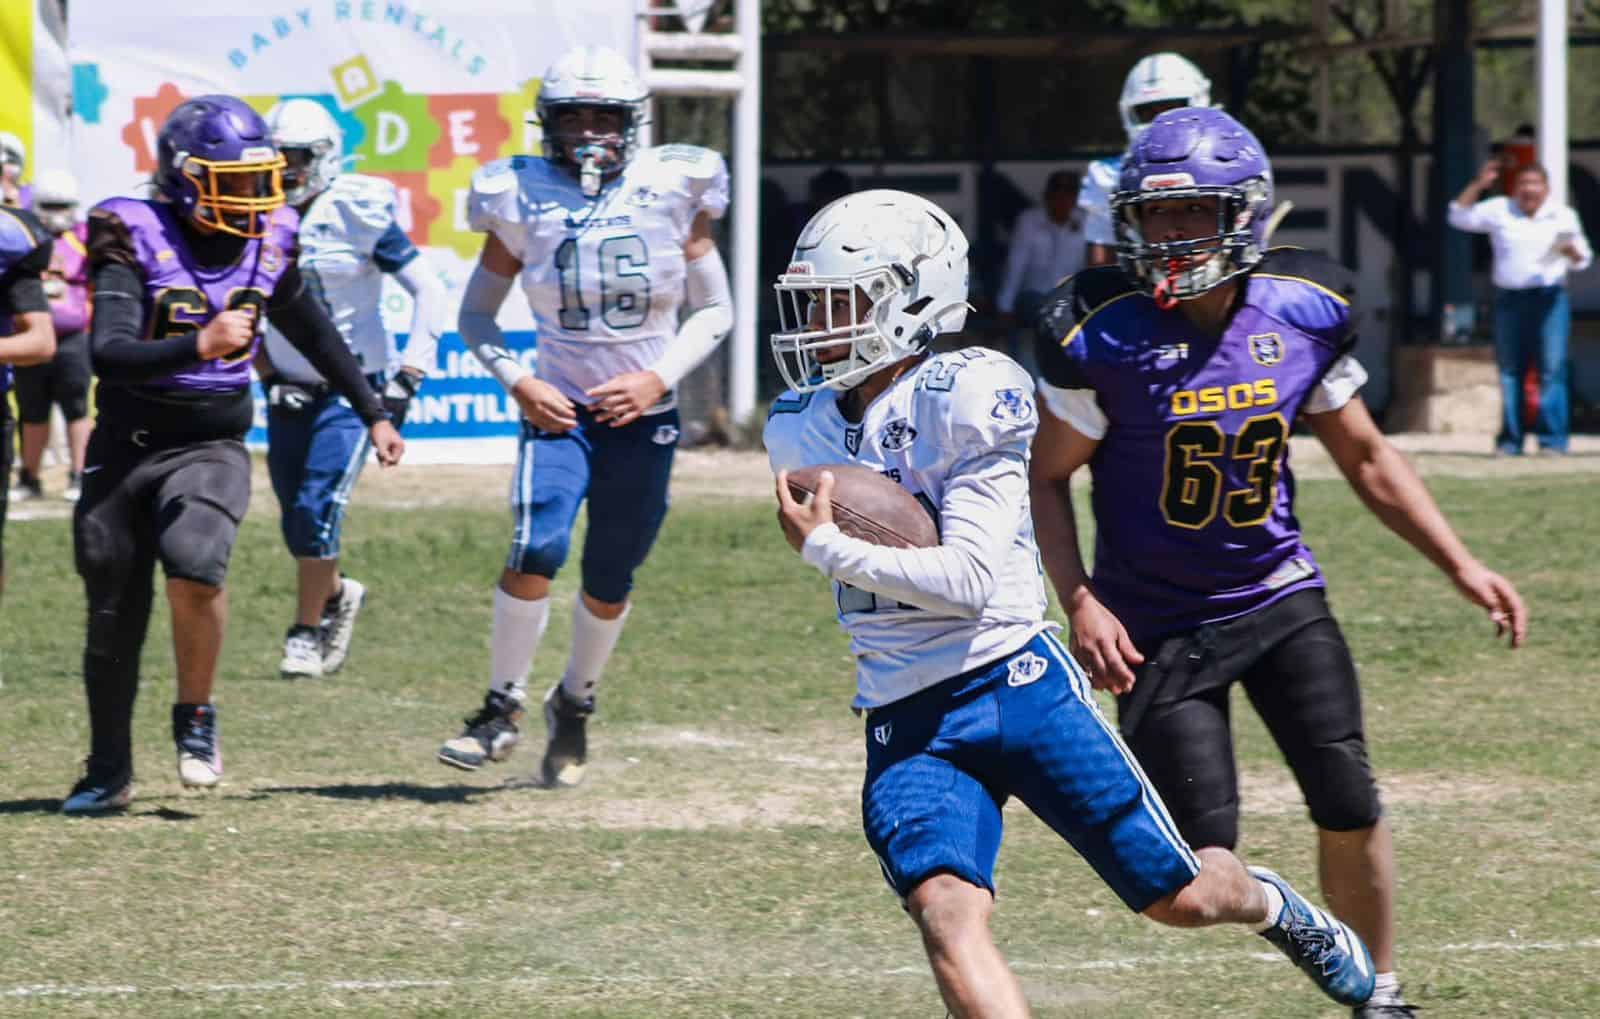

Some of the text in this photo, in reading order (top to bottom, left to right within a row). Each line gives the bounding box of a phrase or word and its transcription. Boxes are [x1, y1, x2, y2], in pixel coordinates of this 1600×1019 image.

[227, 0, 487, 76] BABY RENTALS
[555, 235, 651, 330] 16
[1170, 378, 1278, 416] OSOS
[1159, 412, 1289, 530] 63
